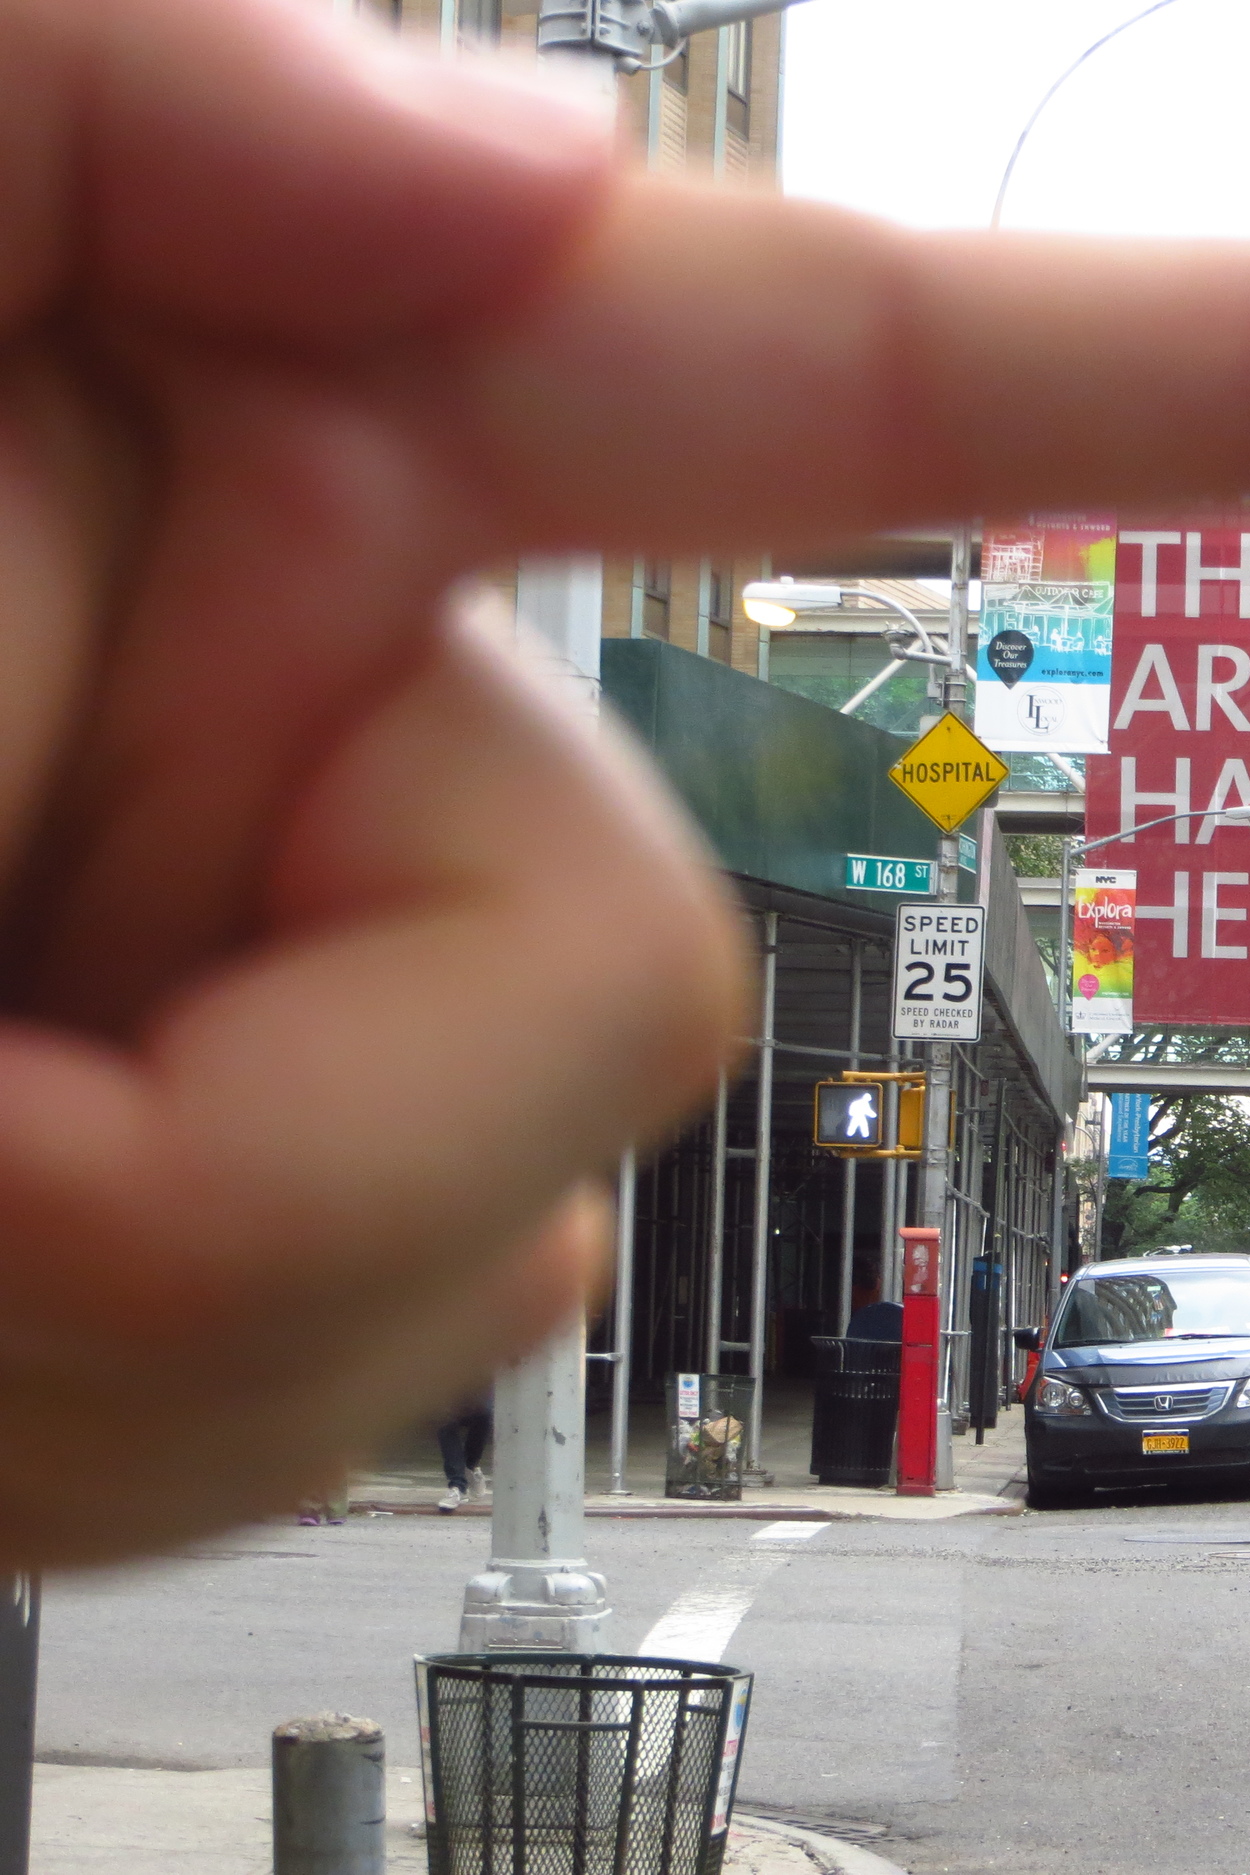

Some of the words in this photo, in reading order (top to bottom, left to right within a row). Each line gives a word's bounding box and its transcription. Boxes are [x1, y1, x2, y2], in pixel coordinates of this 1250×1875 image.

[995, 641, 1027, 651] Discover
[1002, 650, 1018, 659] Our
[993, 659, 1027, 669] Treasures
[1041, 668, 1104, 678] exploranyc.com
[902, 762, 997, 783] HOSPITAL
[852, 859, 866, 884] W
[876, 861, 906, 888] 168
[915, 865, 928, 878] ST
[1095, 876, 1116, 884] NYC
[1078, 895, 1132, 928] Explora
[904, 916, 979, 933] SPEED
[910, 938, 969, 956] LIMIT
[904, 961, 972, 1003] 25
[901, 1007, 929, 1017] SPEED
[934, 1007, 973, 1018] CHECKED
[913, 1019, 925, 1028] BY
[930, 1019, 960, 1029] RADAR
